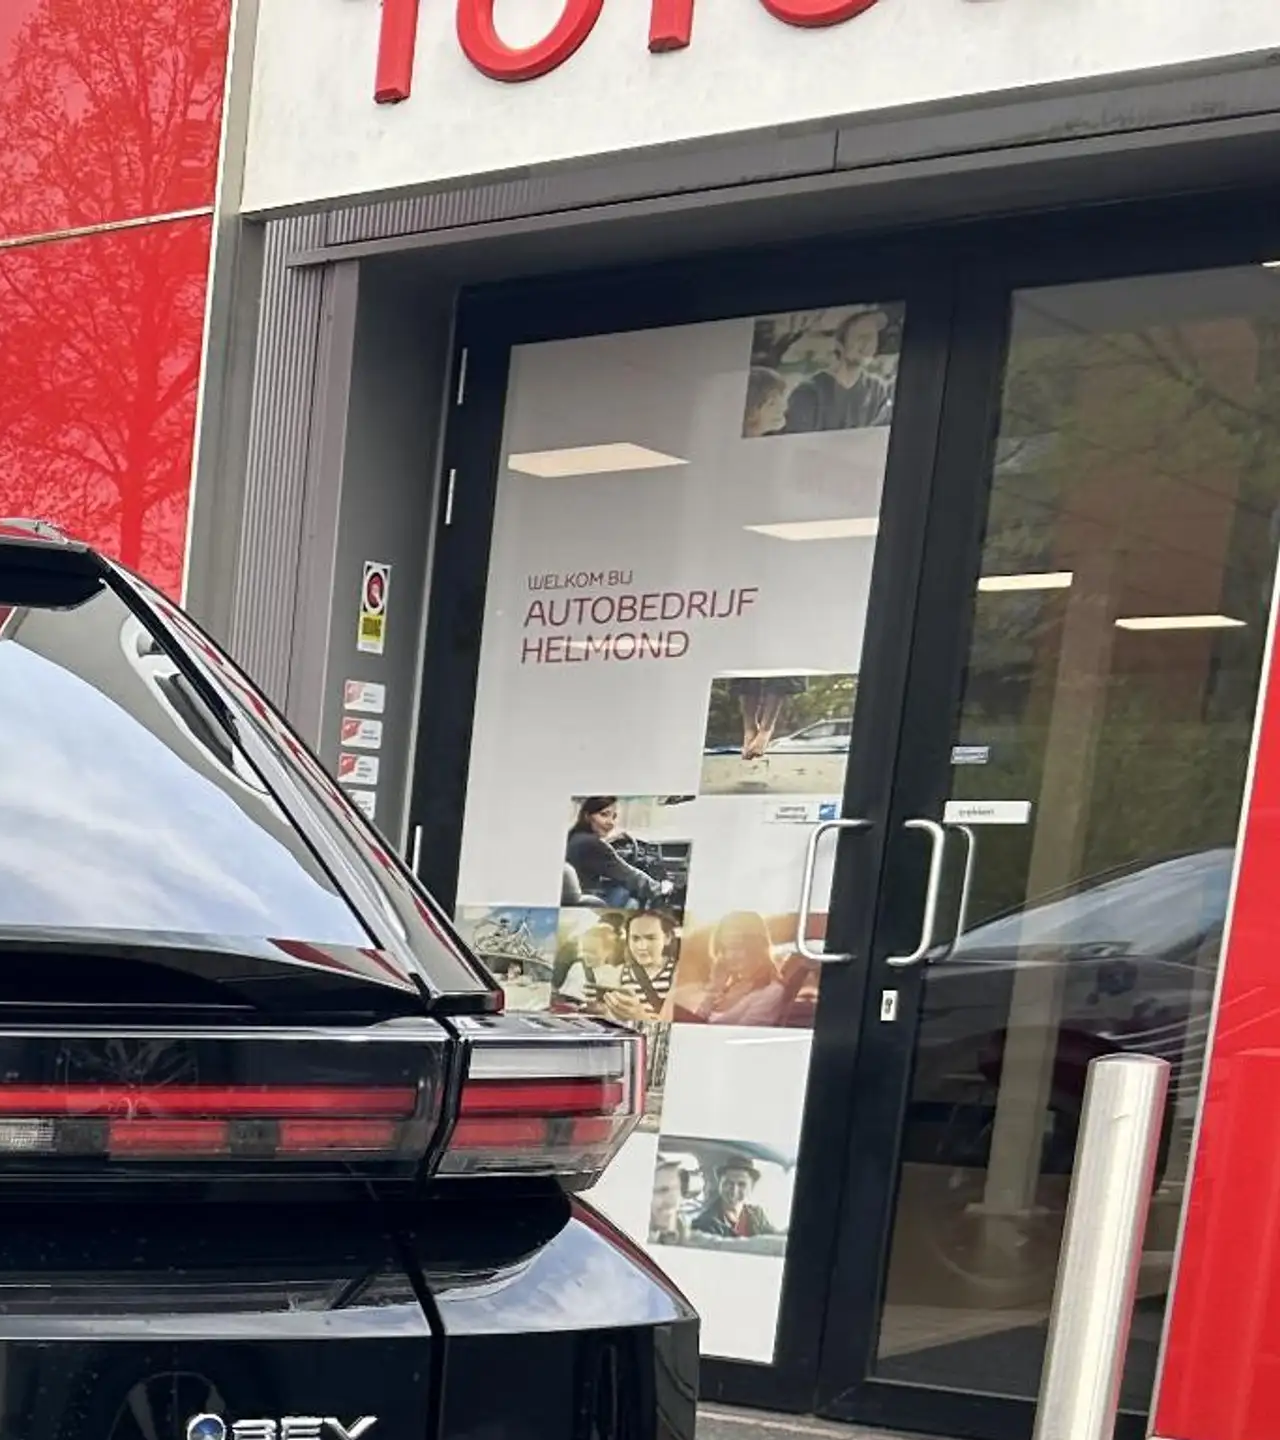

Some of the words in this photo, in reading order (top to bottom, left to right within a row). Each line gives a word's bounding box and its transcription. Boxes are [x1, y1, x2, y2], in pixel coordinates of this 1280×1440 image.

[528, 571, 603, 591] WELKOM
[523, 587, 759, 628] AUTOBEDRIJF
[520, 630, 690, 664] HELMOND
